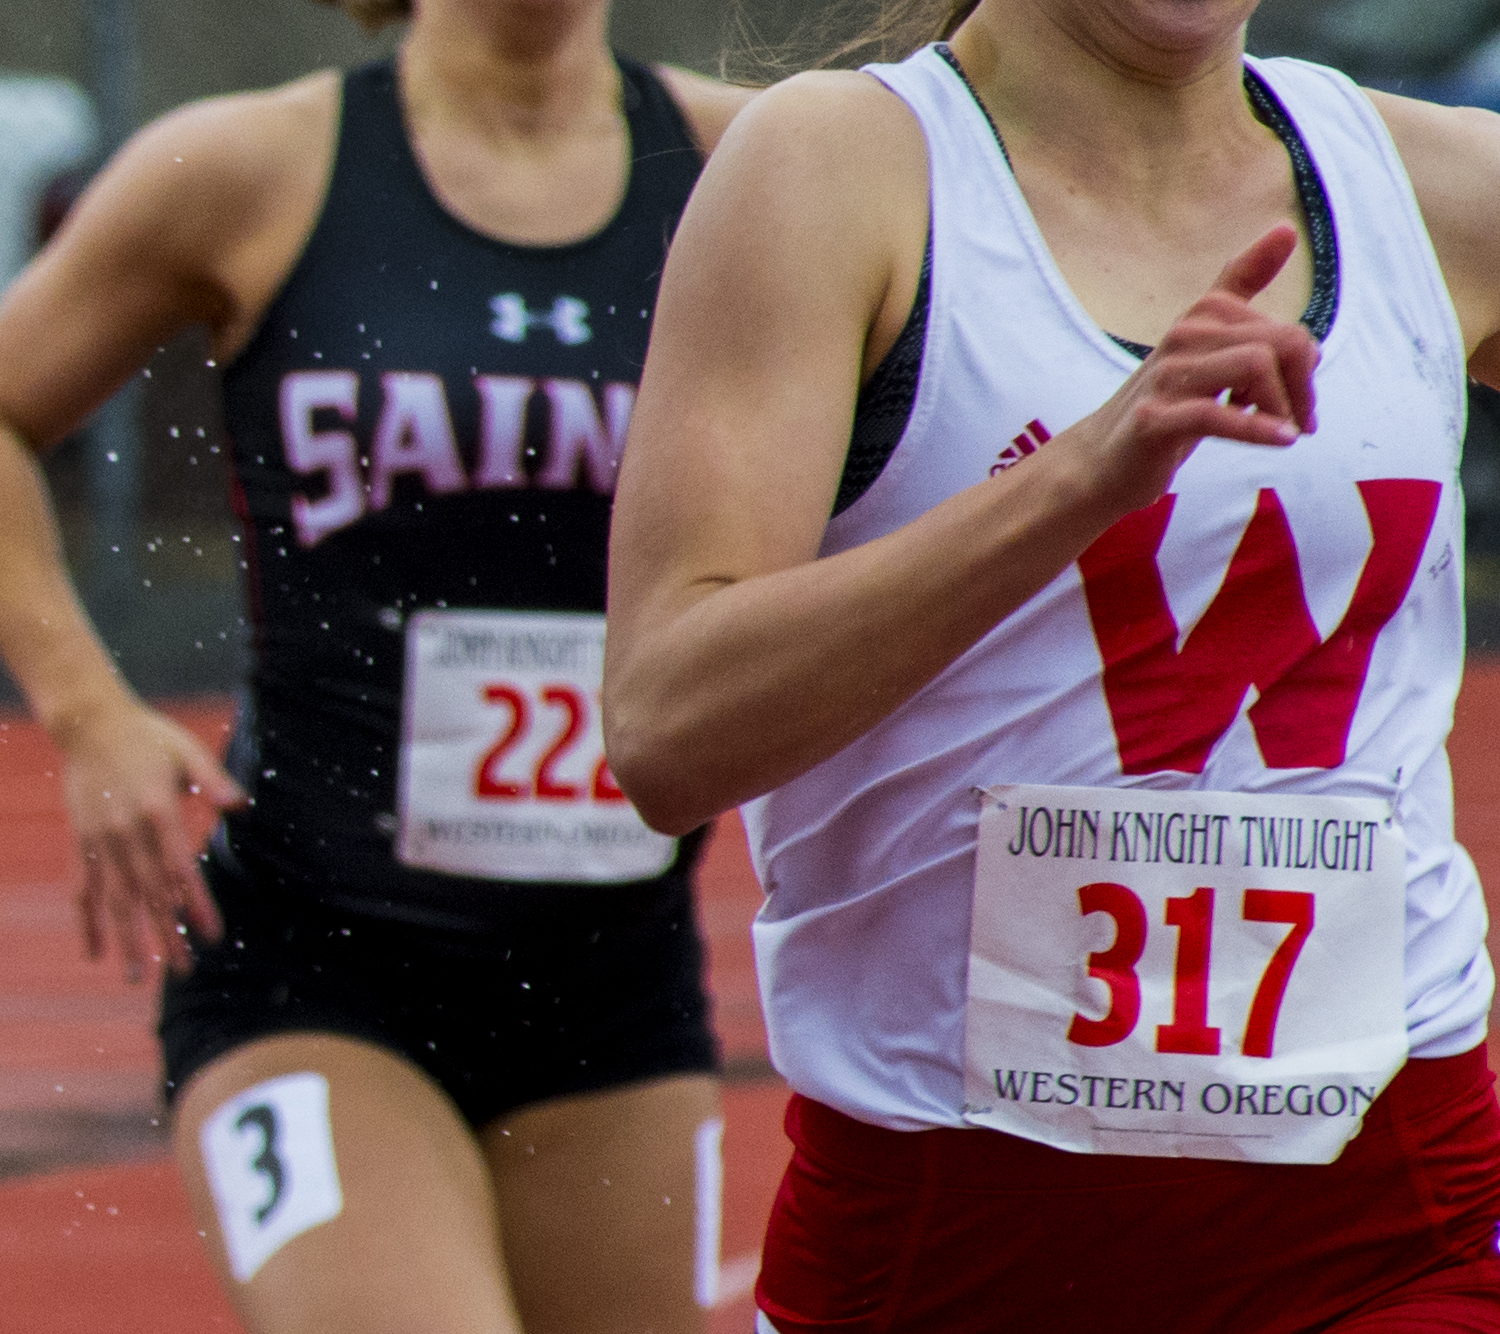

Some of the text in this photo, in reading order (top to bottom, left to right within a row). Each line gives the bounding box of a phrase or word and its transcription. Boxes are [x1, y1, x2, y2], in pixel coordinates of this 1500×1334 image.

[1076, 478, 1443, 775] W
[1009, 806, 1379, 872] JOHN KNIGHT TWILIGHT
[1067, 882, 1316, 1059] 317
[993, 1068, 1377, 1117] WESTERN OREGON
[234, 1103, 284, 1229] 3
